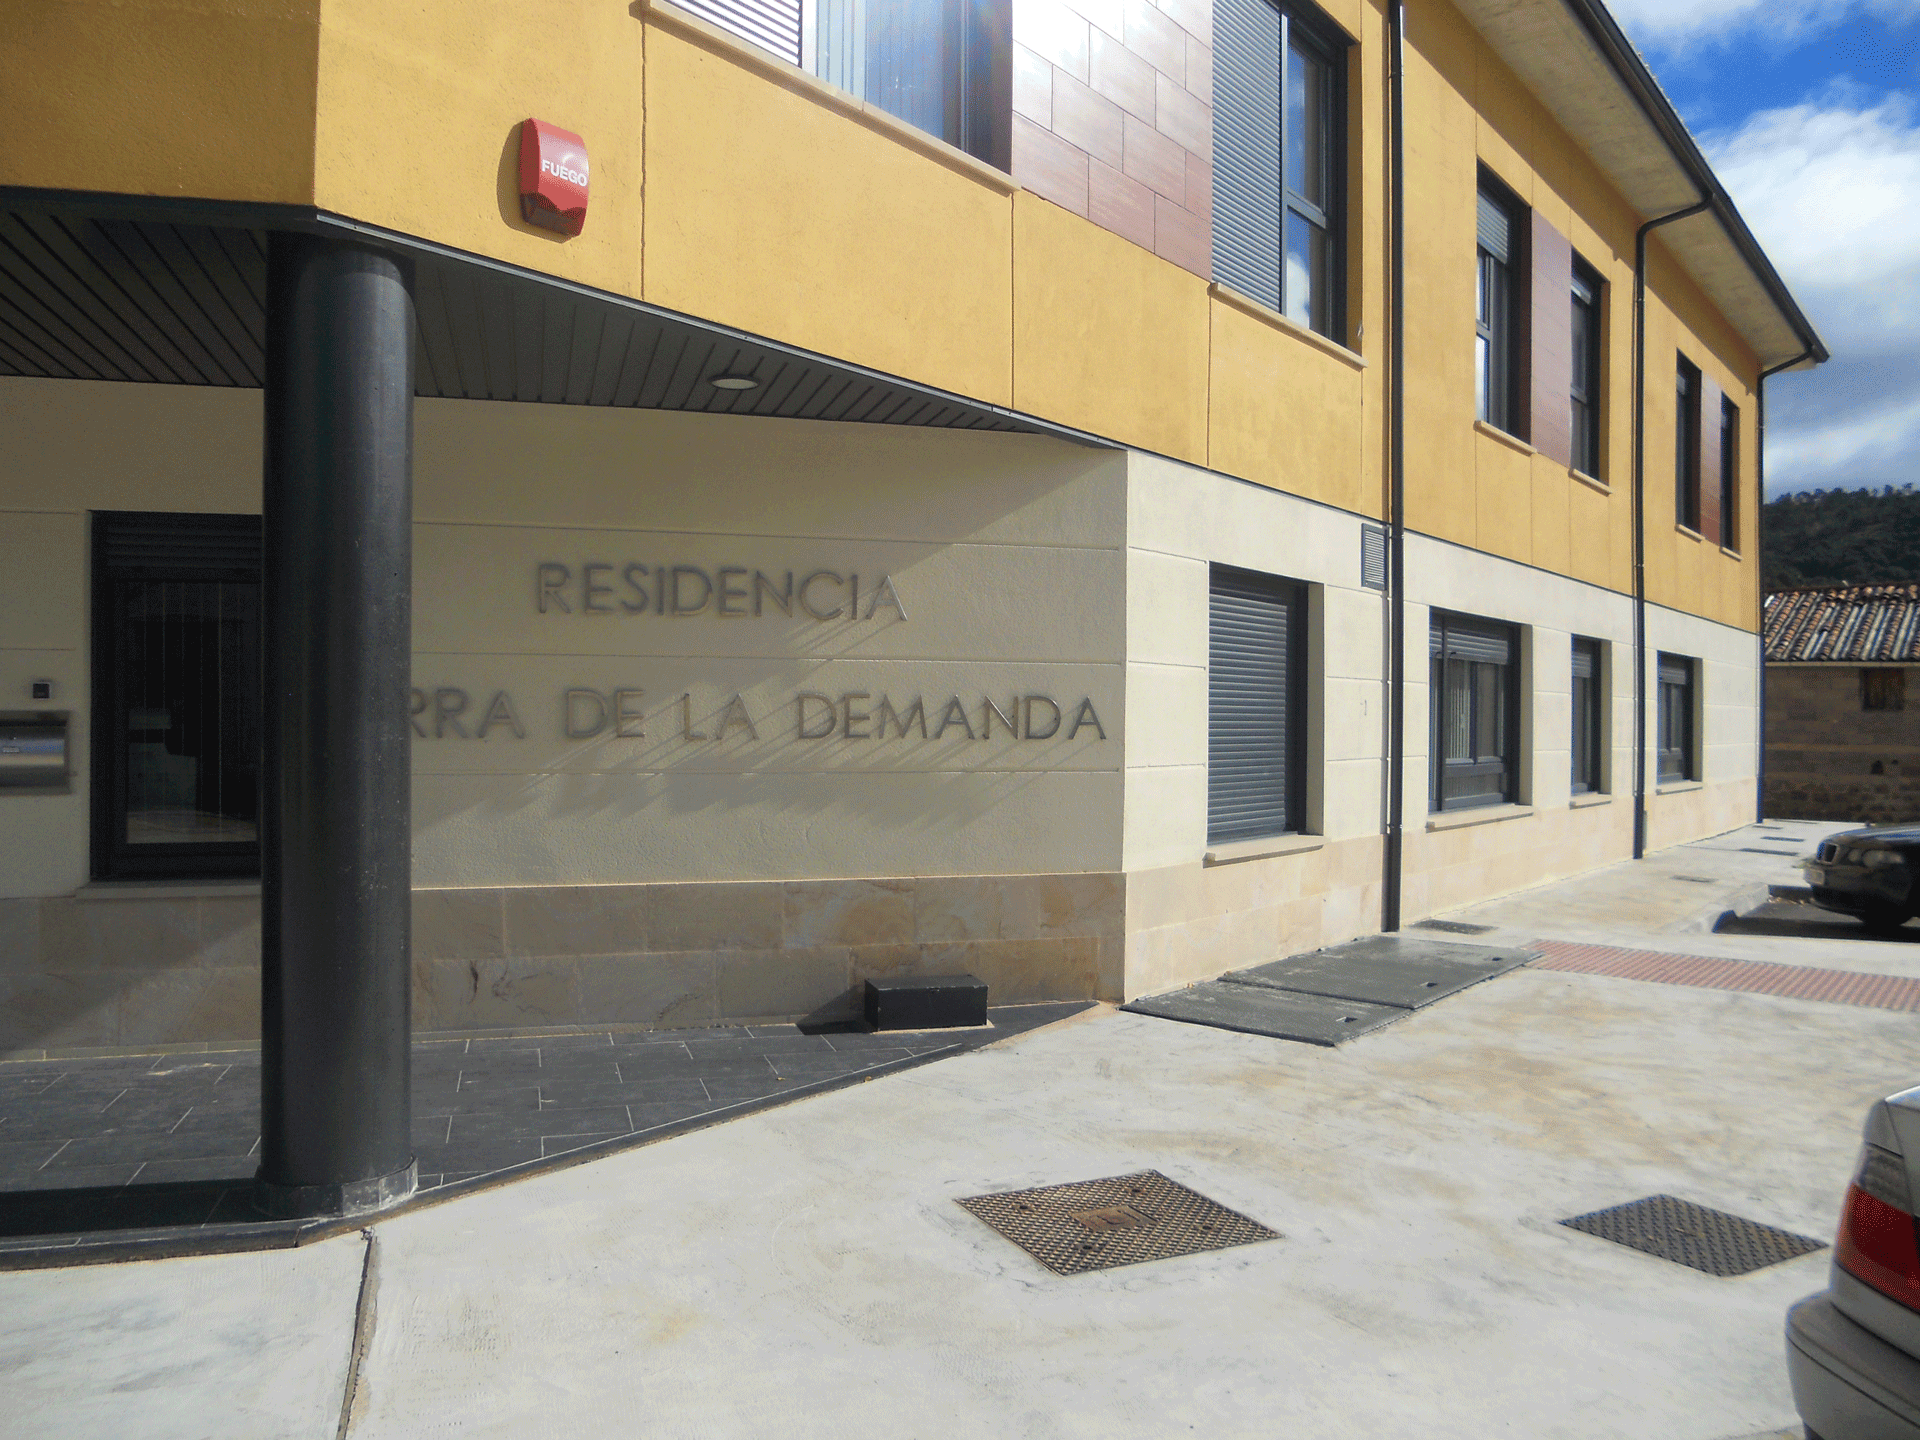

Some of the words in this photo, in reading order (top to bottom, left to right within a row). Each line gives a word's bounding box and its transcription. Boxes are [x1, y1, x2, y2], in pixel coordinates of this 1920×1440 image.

[541, 158, 588, 187] FUEGO
[537, 562, 908, 621] RESIDENCIA
[565, 686, 646, 739] DE
[682, 692, 760, 741] LA
[798, 693, 1107, 741] DEMANDA
